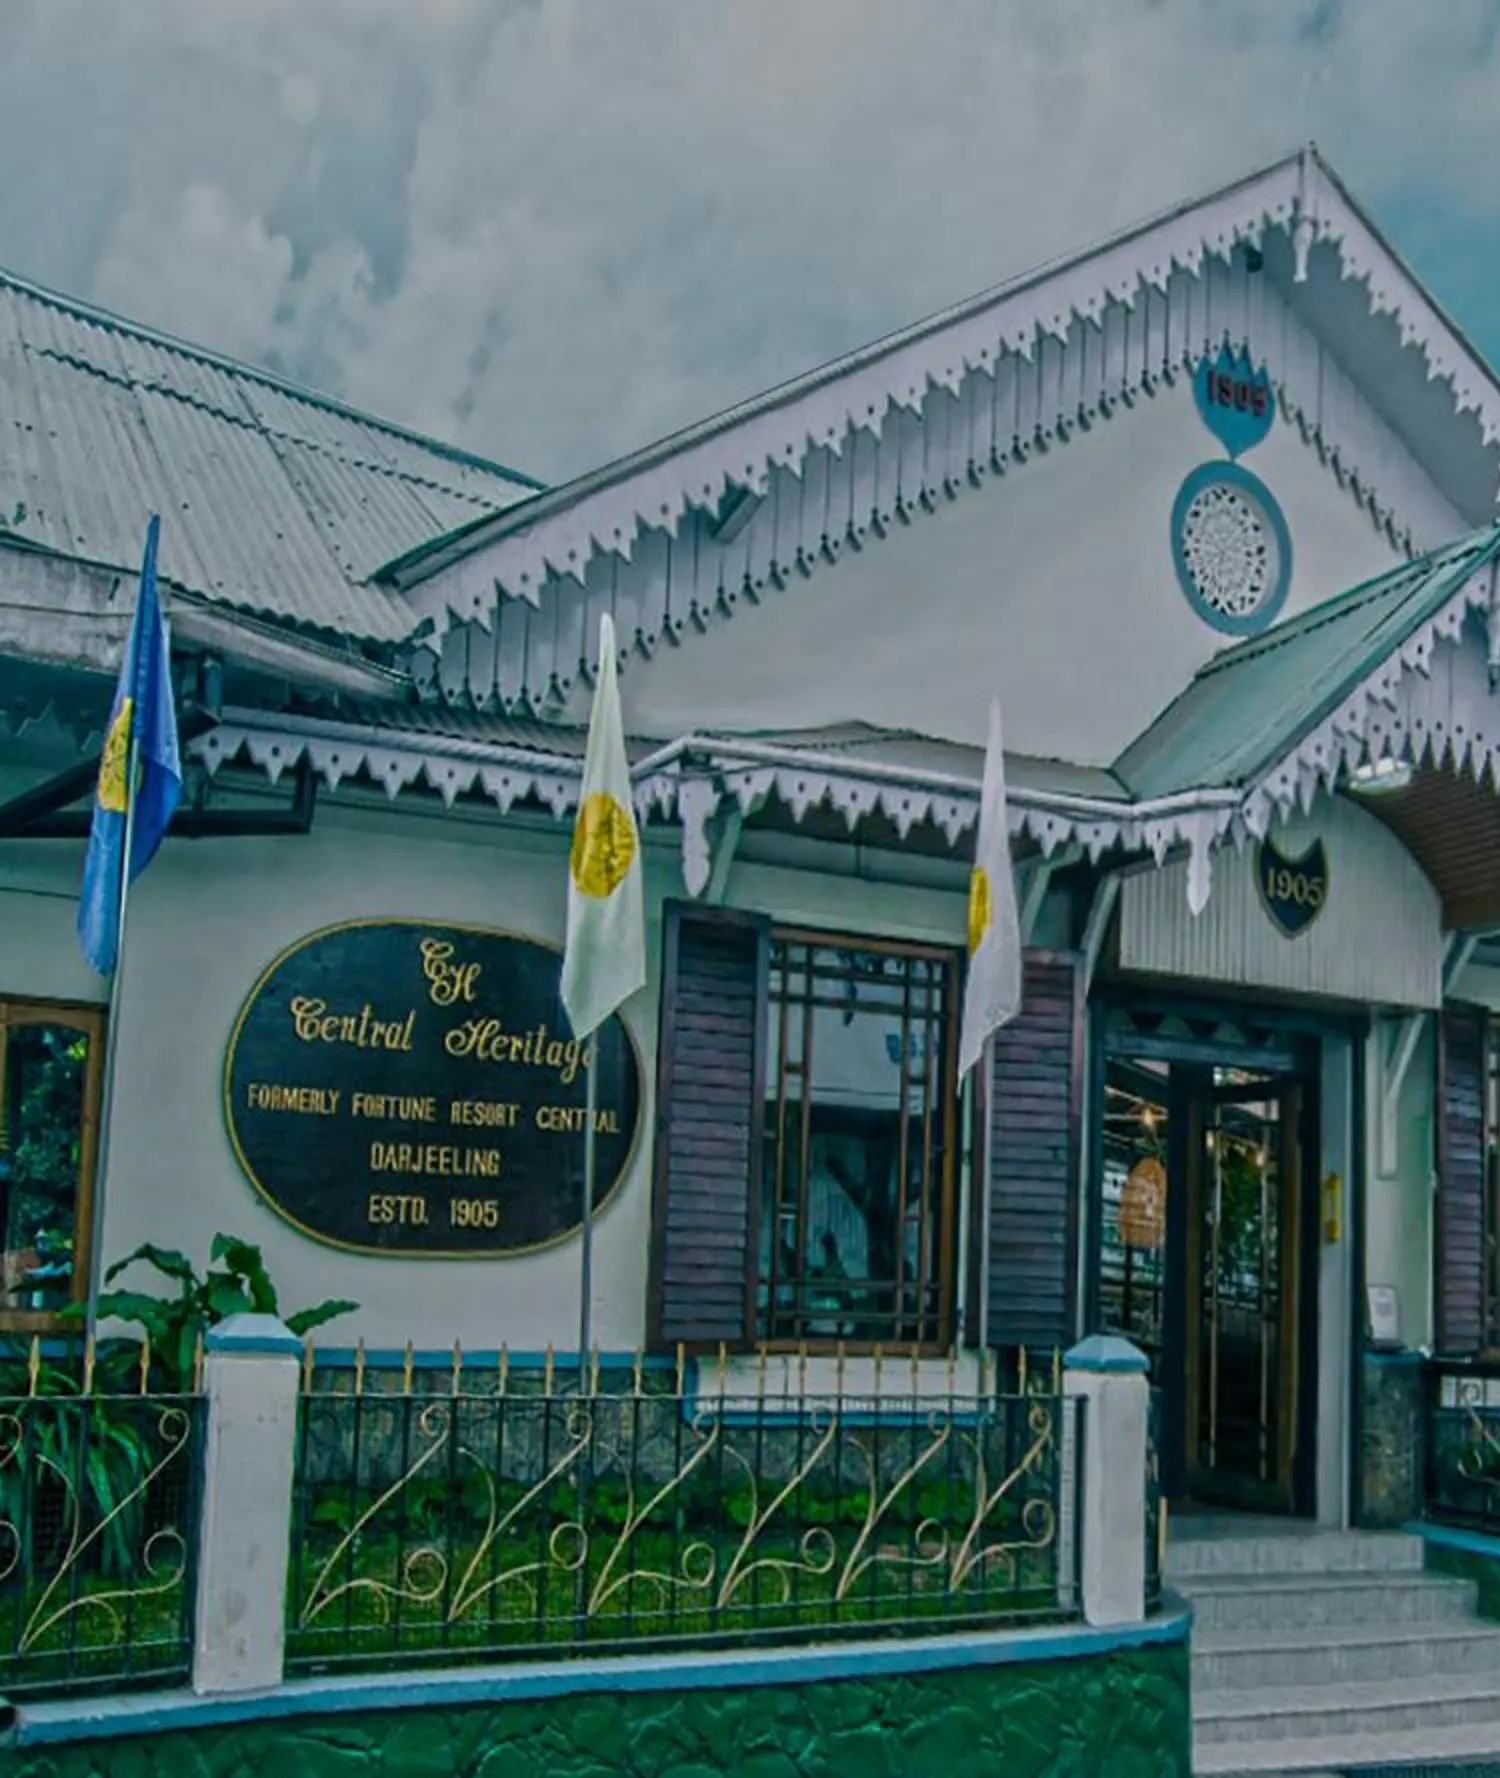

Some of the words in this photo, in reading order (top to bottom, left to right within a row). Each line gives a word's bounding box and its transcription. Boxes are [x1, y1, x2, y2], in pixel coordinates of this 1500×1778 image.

[1268, 867, 1324, 906] 1905
[291, 996, 416, 1051] Central
[247, 1083, 340, 1116] FORMERLY
[351, 1091, 437, 1122] FORTUNE
[450, 1100, 520, 1128] RESORT
[370, 1141, 501, 1177] DARJEELING
[368, 1194, 429, 1225] ESTD.
[450, 1199, 499, 1228] 1905
